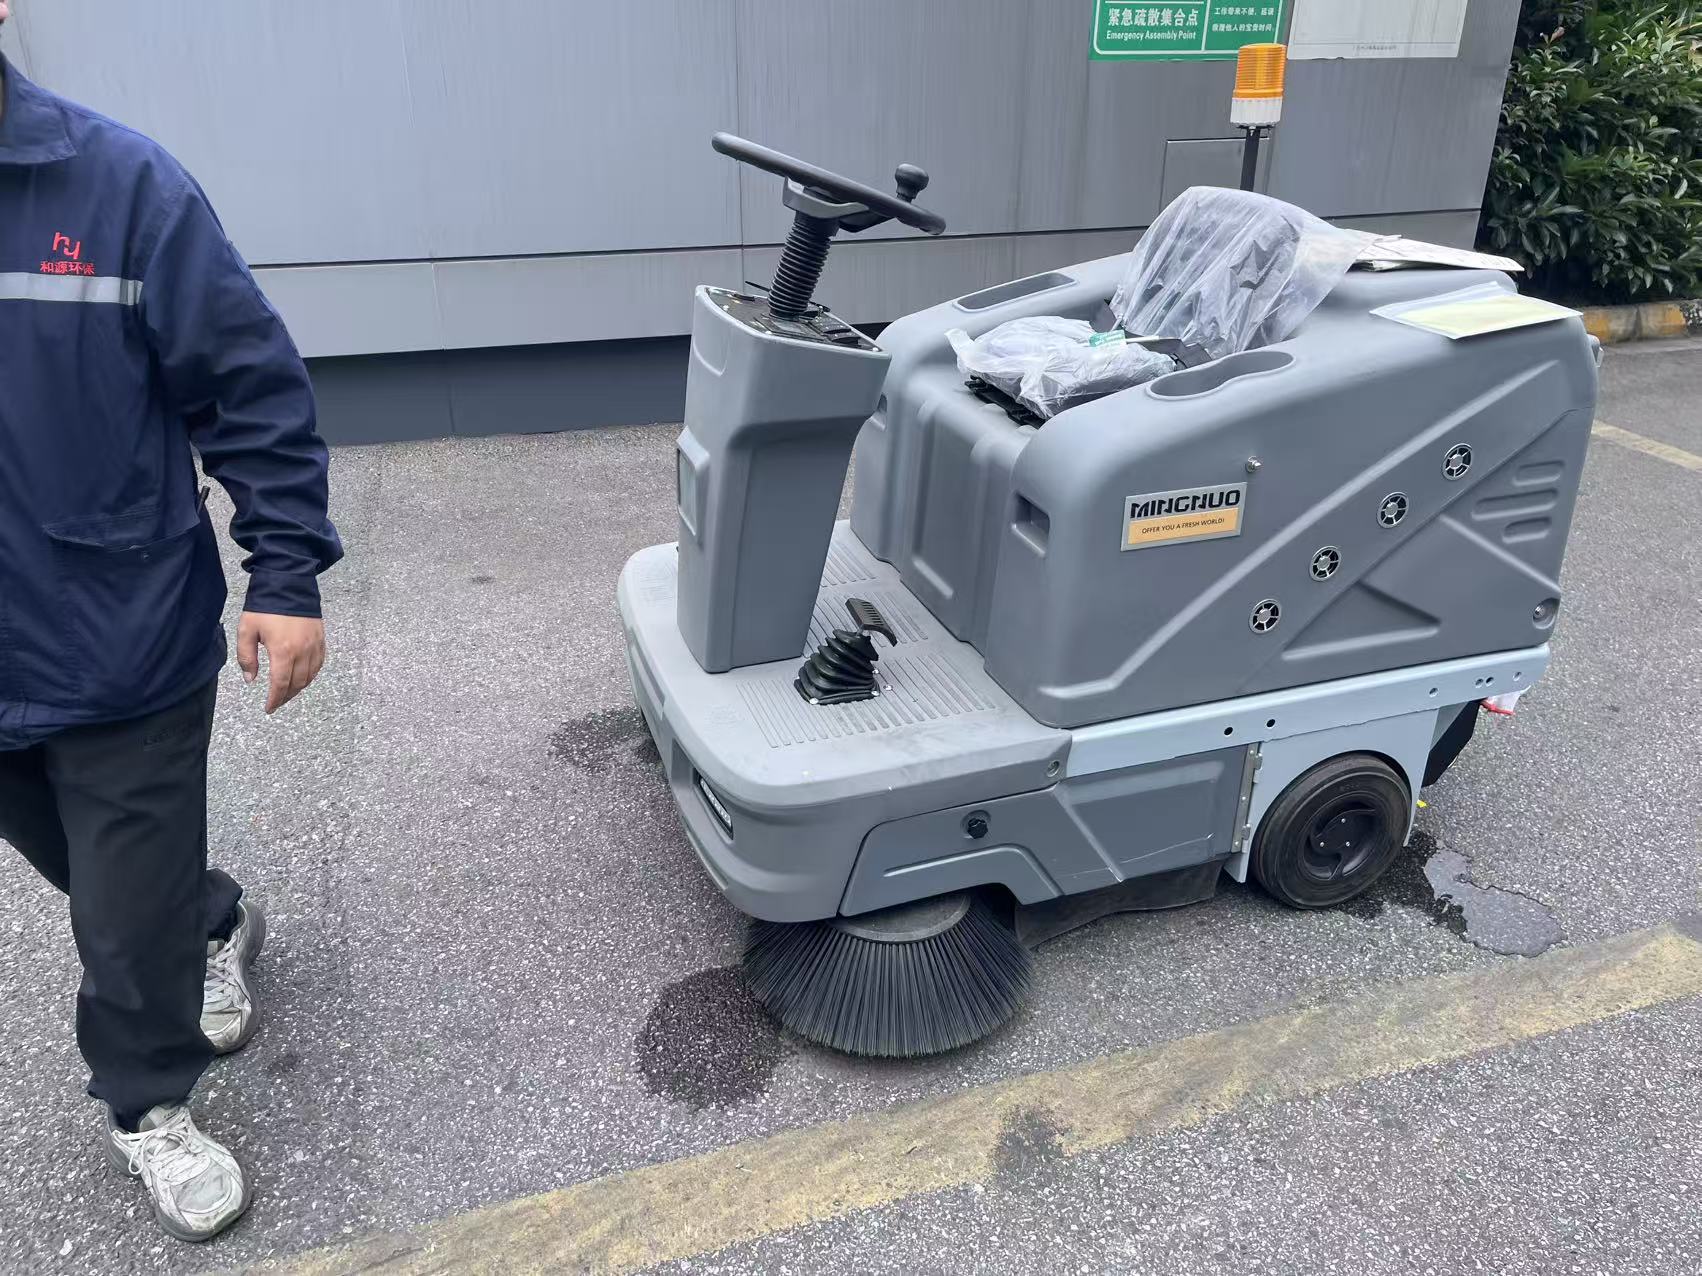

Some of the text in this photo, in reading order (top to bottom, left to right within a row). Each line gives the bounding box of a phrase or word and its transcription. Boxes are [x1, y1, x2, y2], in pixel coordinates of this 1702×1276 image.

[1108, 8, 1199, 26] 紧急疏散集合点
[1106, 30, 1197, 41] Emergency Assembly Point
[40, 260, 96, 275] 和源环保
[1129, 489, 1241, 519] MINGNUO
[1141, 518, 1225, 535] OFFER YOU A FRESH WORLD!
